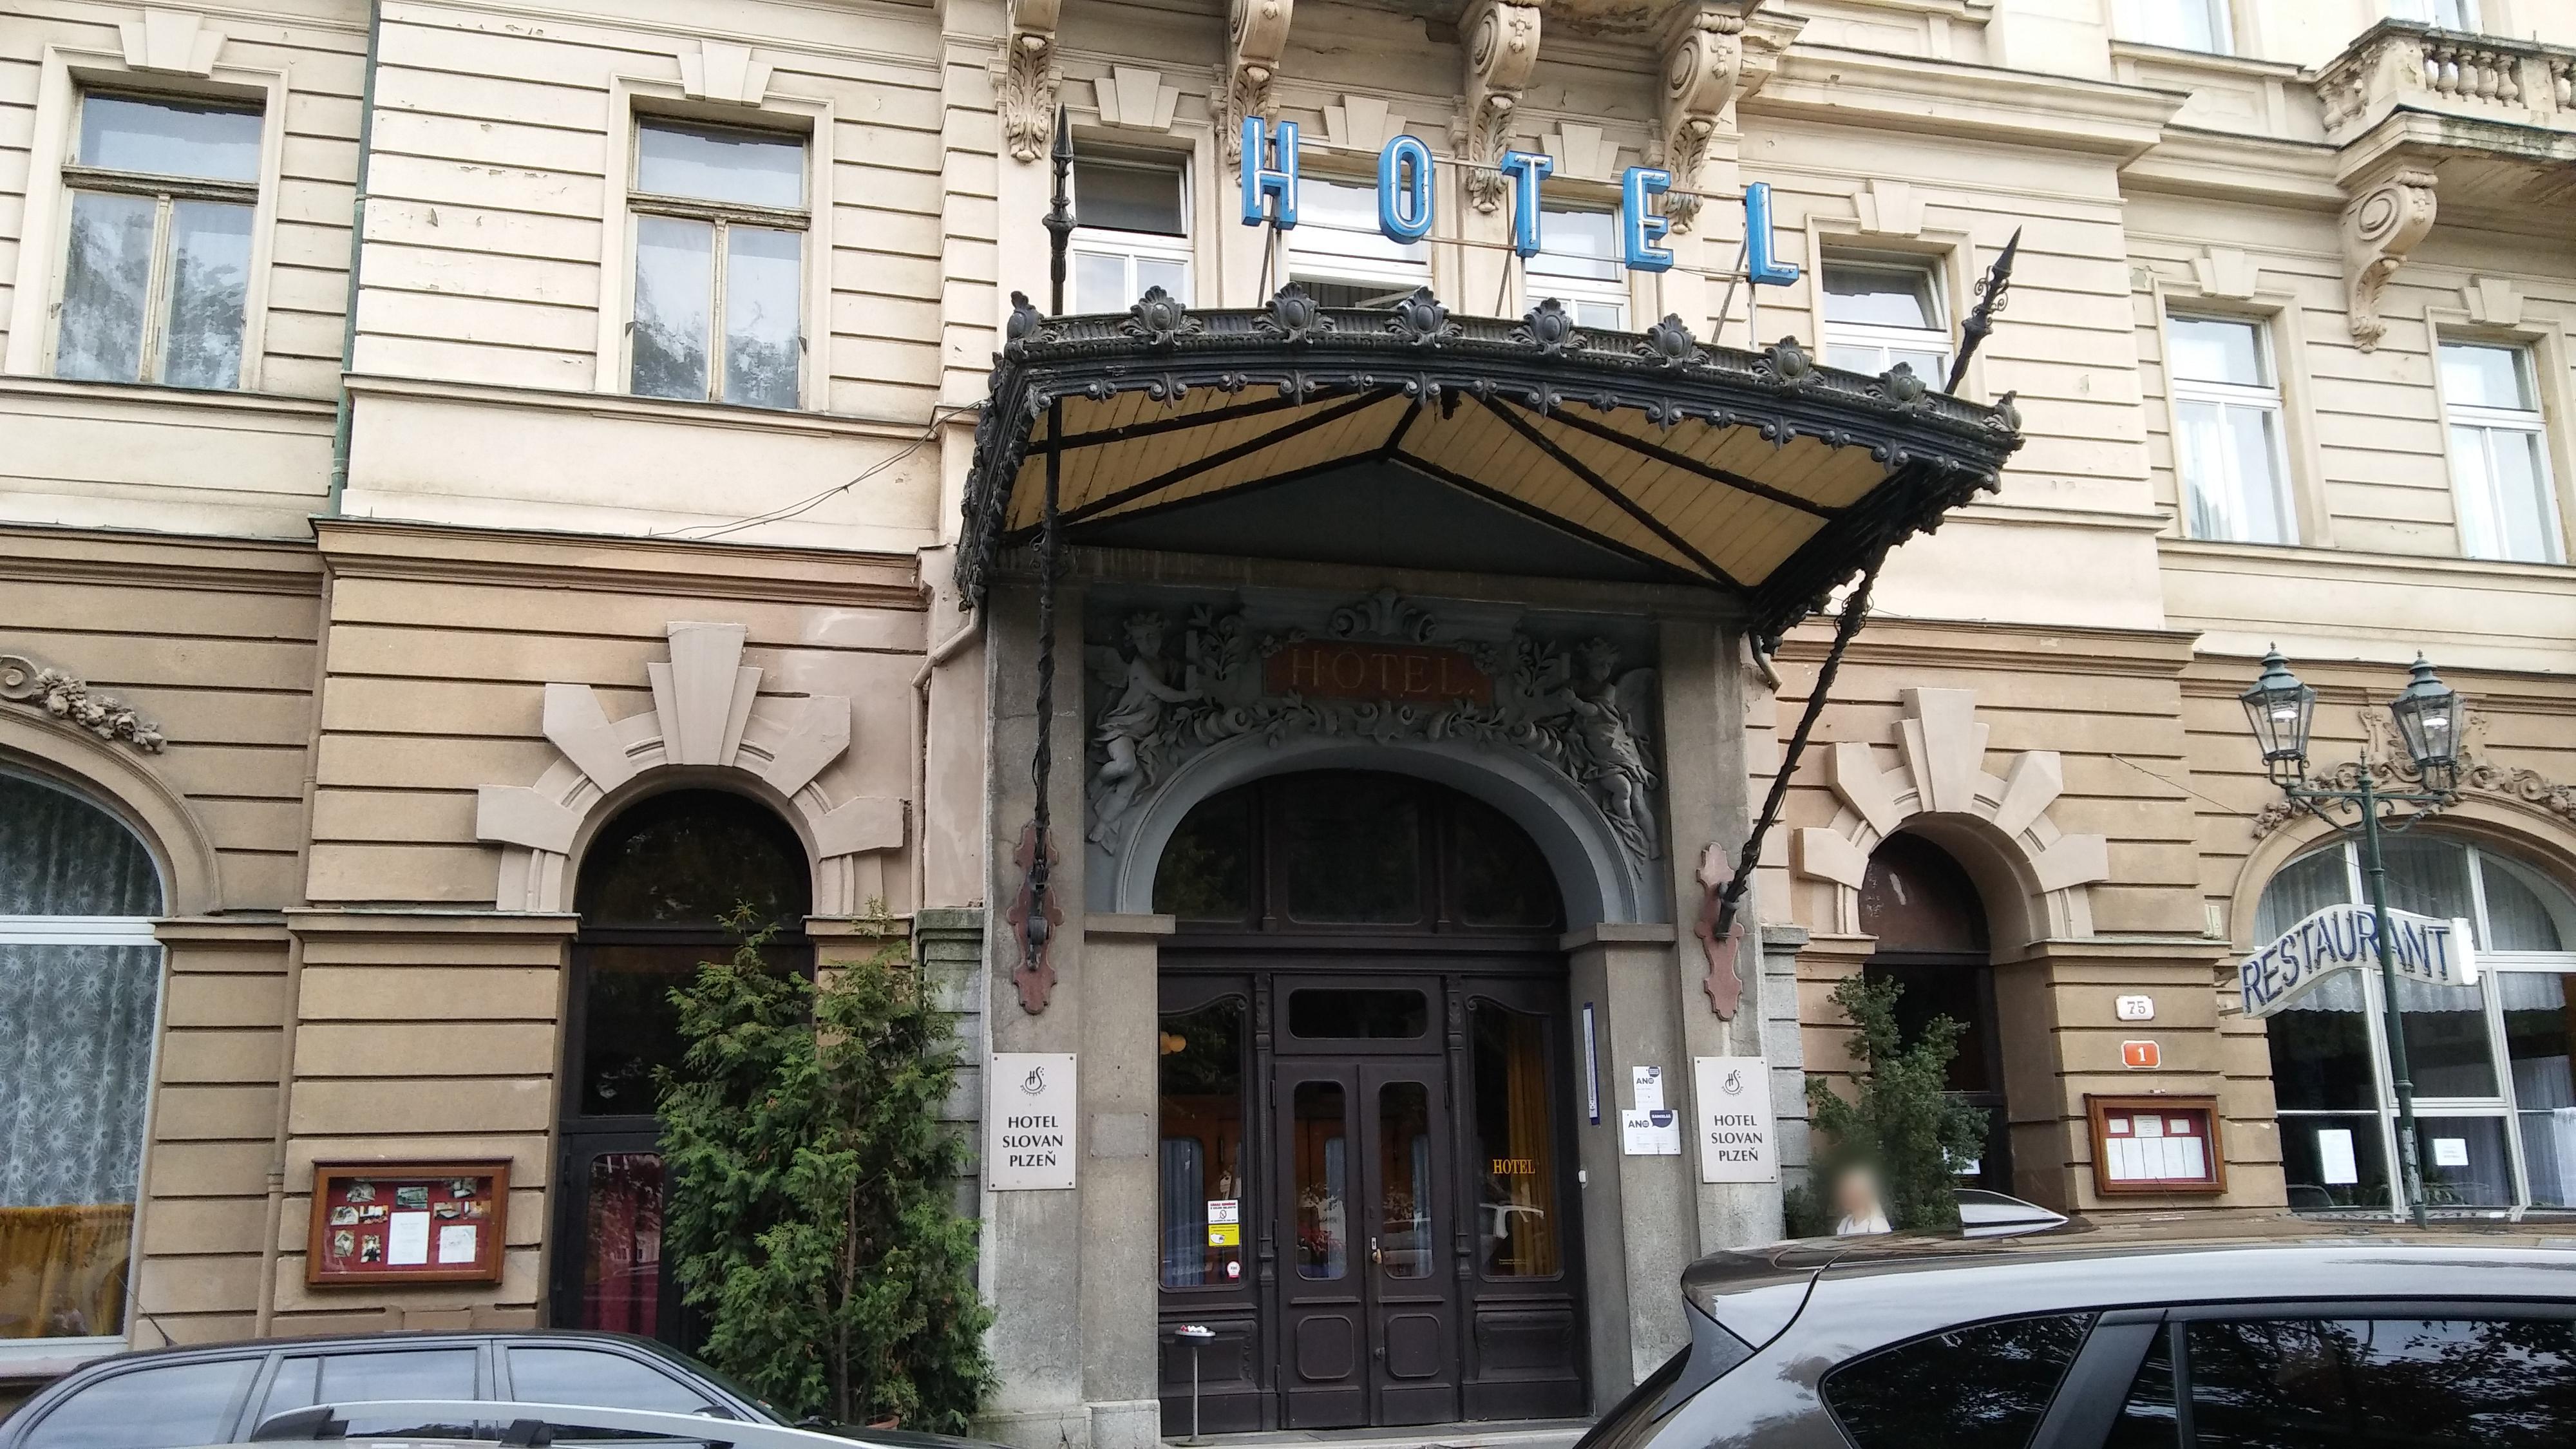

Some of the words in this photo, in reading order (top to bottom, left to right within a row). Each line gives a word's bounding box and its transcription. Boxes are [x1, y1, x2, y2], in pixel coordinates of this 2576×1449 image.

[1241, 115, 1800, 287] HOTEL
[2242, 910, 2450, 1014] RESTAURANT
[2127, 1001, 2146, 1015] 75
[2137, 1046, 2146, 1063] 1
[1008, 1115, 1059, 1128] HOTEL
[1628, 1120, 1649, 1128] ANO
[1714, 1115, 1757, 1126] HOTEL
[1002, 1135, 1063, 1148] SLOVAN
[1710, 1132, 1763, 1144] SLOVAN
[1009, 1150, 1056, 1167] PLZEŇ
[1718, 1147, 1759, 1162] PLZEŇ
[1493, 1159, 1536, 1175] HOTEL
